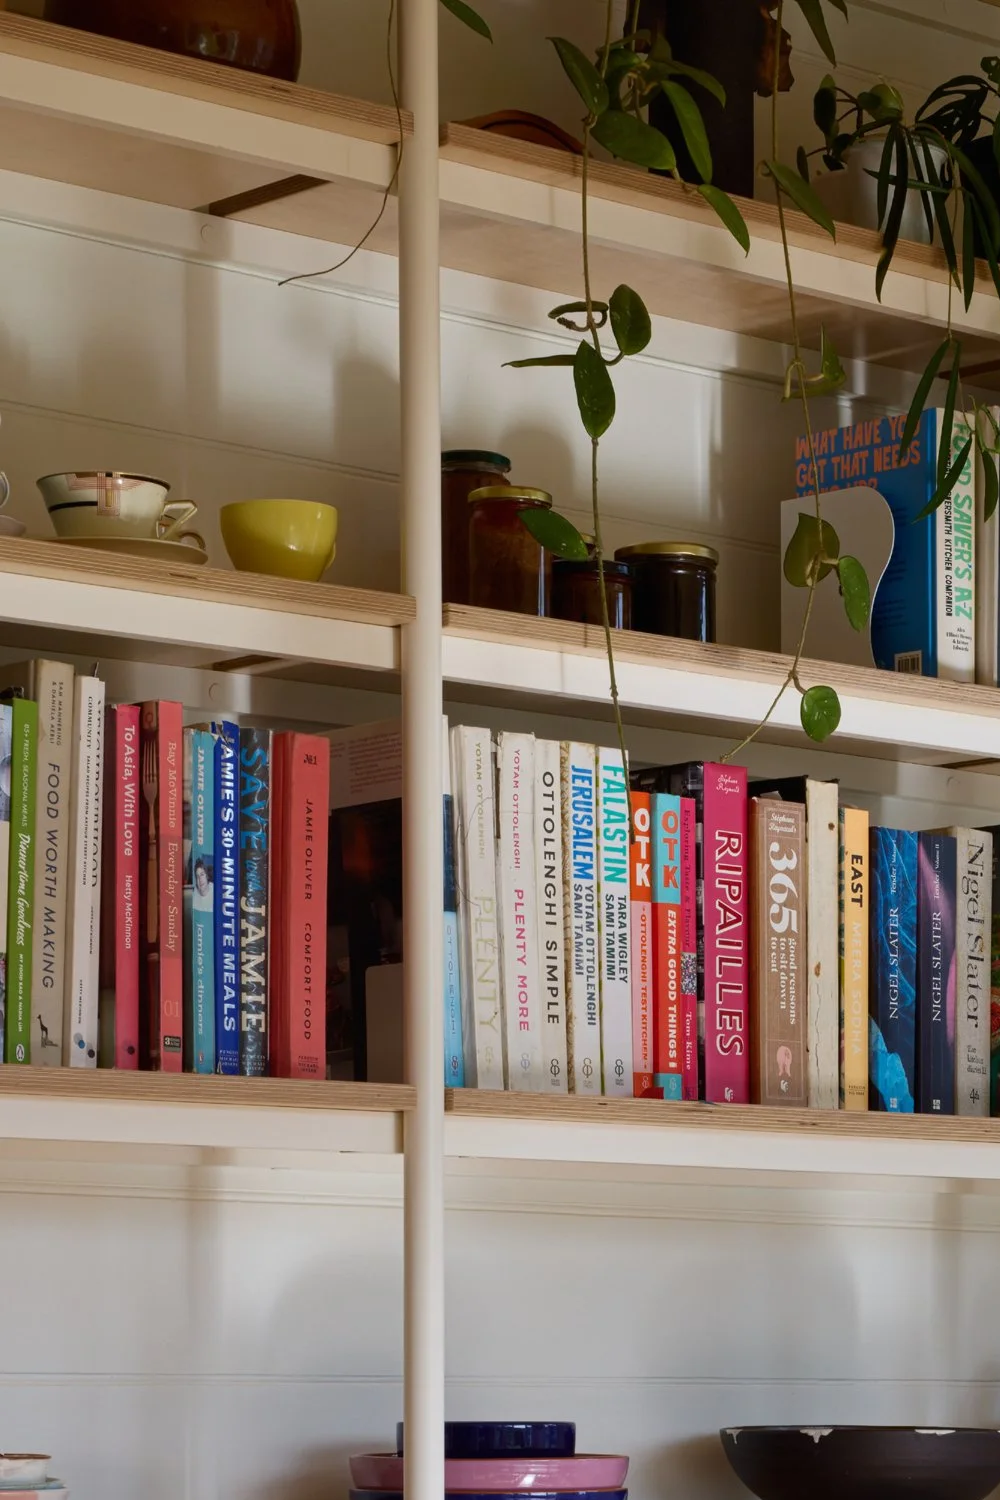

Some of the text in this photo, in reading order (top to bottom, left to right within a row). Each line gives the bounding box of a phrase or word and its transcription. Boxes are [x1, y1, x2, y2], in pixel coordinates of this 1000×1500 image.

[796, 418, 882, 460] WHAT HAVE
[796, 459, 827, 488] GOT
[832, 450, 869, 481] THAT
[874, 440, 921, 473] NEEDS
[945, 538, 953, 617] KITCHEN COMPANION
[953, 493, 973, 576] SAVER'S
[21, 764, 30, 827] SEASONAL MEALS
[166, 741, 177, 766] Ray
[196, 745, 205, 791] JAMIE
[122, 725, 136, 950] To Asia, With Love Hetty McKinnon
[196, 794, 205, 845] OLIVER
[239, 746, 267, 850] SAVE
[570, 764, 595, 881] JERUSALEM
[602, 764, 628, 884] FALASTIN
[683, 809, 691, 861] Exploring
[16, 832, 32, 946] Dinnertime Goodness
[41, 762, 61, 989] FOOD WORTH MAKING
[165, 842, 178, 897] Everyday
[221, 828, 236, 947] 30-MINUTE
[473, 741, 499, 1035] YOTAM OTTOLENGHI PLENTY
[511, 749, 529, 1032] YOTAM OTTOLENGHI PLENTY MORE
[634, 807, 651, 887] OTK
[662, 810, 679, 889] OTK
[768, 841, 798, 934] 365
[962, 840, 985, 923] Nigel
[165, 905, 178, 951] Sunday
[303, 798, 314, 1041] JAMIE OLIVER COMFORT FOOD
[541, 770, 560, 1025] OTTOLENGHI SIMPLE
[573, 883, 585, 976] SAMI TAMIMI
[605, 893, 617, 981] SAMI TAMIMI
[617, 894, 629, 984] TARA WIGLEY
[889, 907, 899, 968] SLATER
[932, 911, 942, 970] SLATER
[240, 896, 266, 1033] JAMIE
[584, 884, 597, 1026] YOTAM OTTOLENGHI
[639, 913, 649, 1060] OTTOLENGHI TEST KITCHEN
[666, 908, 678, 1060] EXTRA GOOD THINGS
[714, 829, 744, 1056] RIPAILLES
[770, 937, 779, 973] to eat
[779, 937, 788, 1009] to sit down
[788, 937, 798, 1025] good reasons
[850, 853, 864, 1055] EAST MEERA SODHA
[966, 932, 985, 1028] Slater
[222, 953, 236, 1032] MEALS
[889, 972, 899, 1020] NIGEL
[932, 972, 942, 1022] NIGEL
[685, 1041, 693, 1071] Kime
